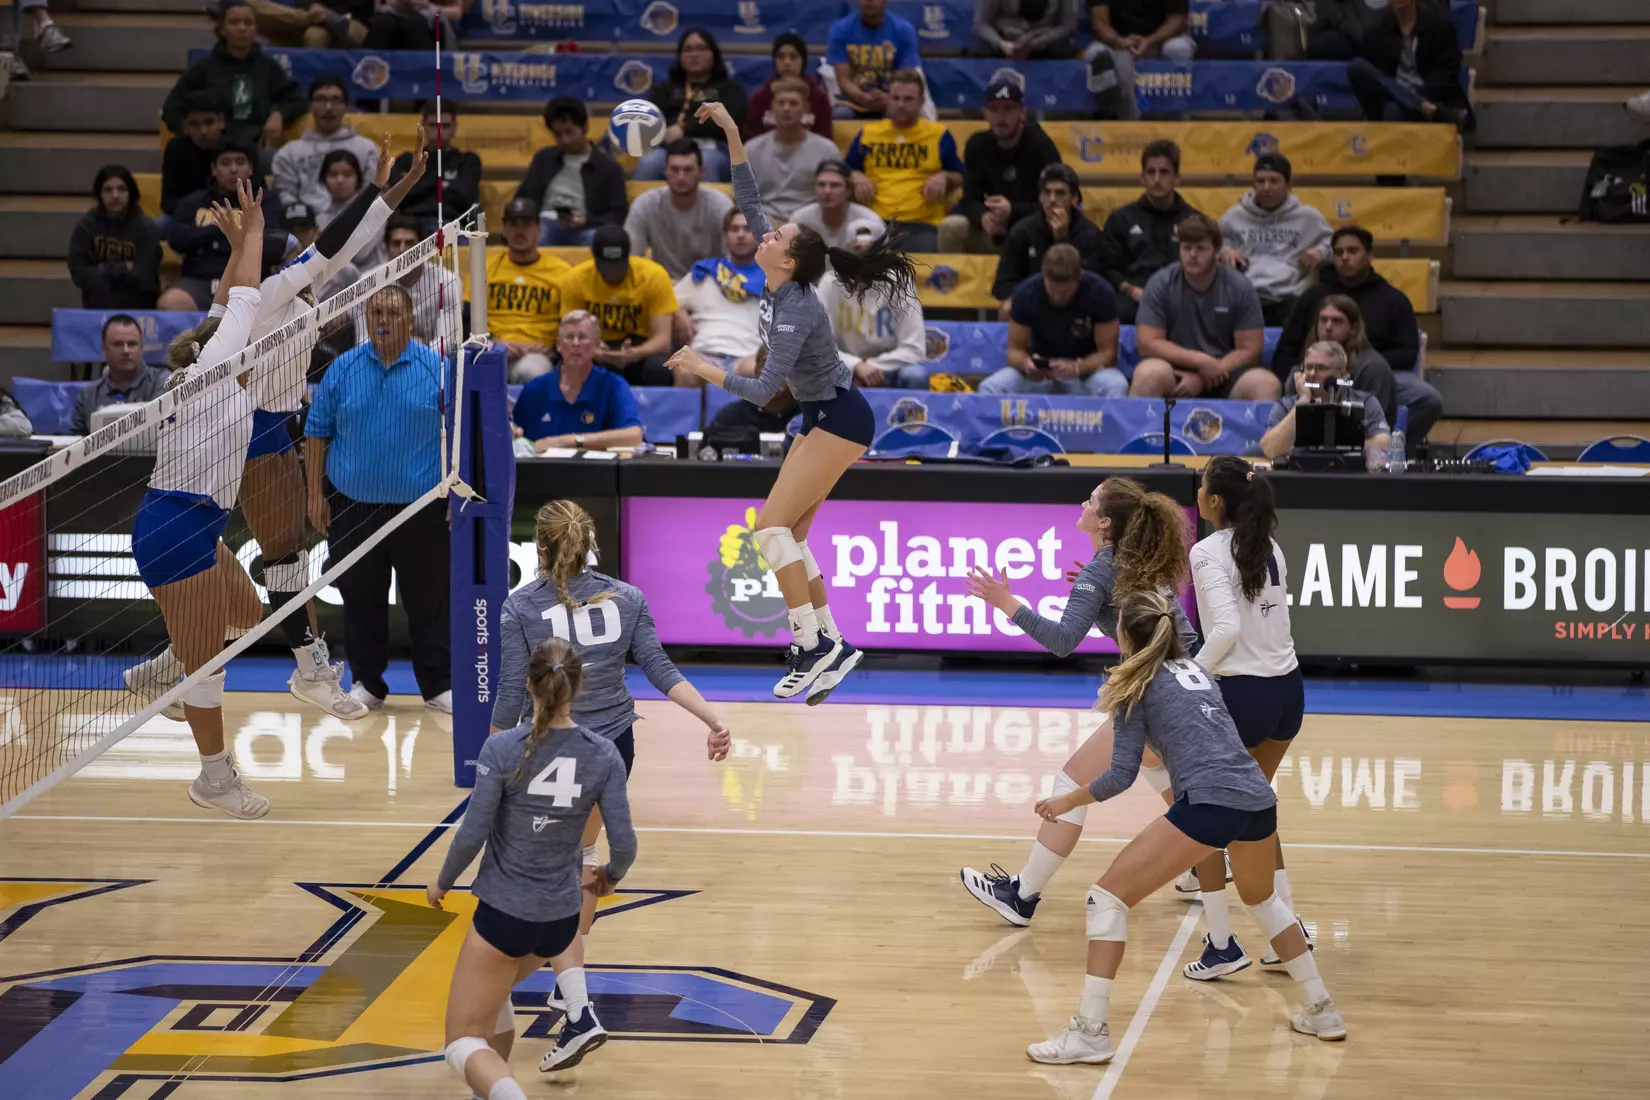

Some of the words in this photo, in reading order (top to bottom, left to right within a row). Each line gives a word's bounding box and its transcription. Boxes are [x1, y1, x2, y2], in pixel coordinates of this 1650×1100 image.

[831, 521, 1062, 587] planet
[1286, 543, 1423, 608] AME
[1503, 547, 1650, 612] BROI
[474, 599, 489, 645] sports
[541, 600, 622, 646] 10
[1554, 621, 1636, 640] SIMPLY
[527, 757, 582, 808] 4
